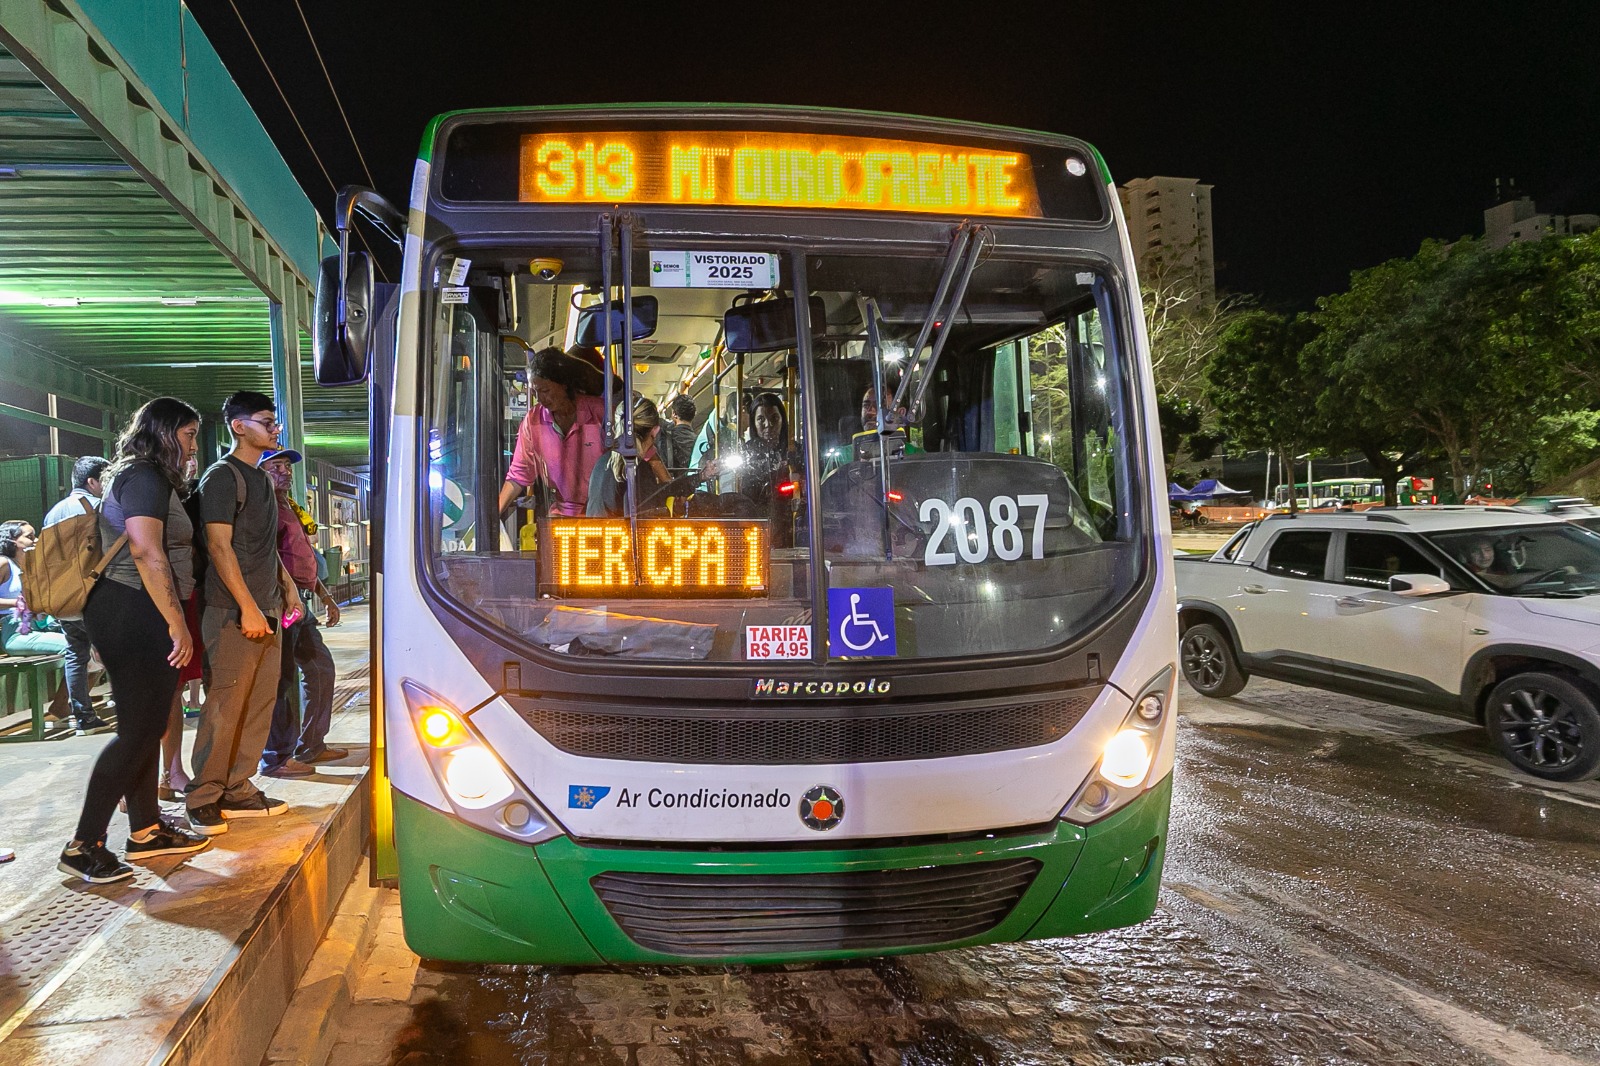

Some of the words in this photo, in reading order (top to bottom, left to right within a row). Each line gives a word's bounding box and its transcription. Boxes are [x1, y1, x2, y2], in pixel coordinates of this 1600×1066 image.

[537, 141, 635, 197] 313
[694, 255, 766, 265] VISTORIADO
[708, 266, 753, 279] 2025
[919, 494, 1049, 566] 2087
[554, 526, 629, 585] TER
[646, 526, 726, 585] CPA
[746, 526, 761, 585] 1
[749, 627, 809, 642] TARIFA
[750, 643, 771, 658] R$
[775, 643, 809, 658] 4,95
[755, 678, 891, 696] Marcopolo
[616, 788, 642, 808] Ar
[647, 788, 792, 808] Condicionado
